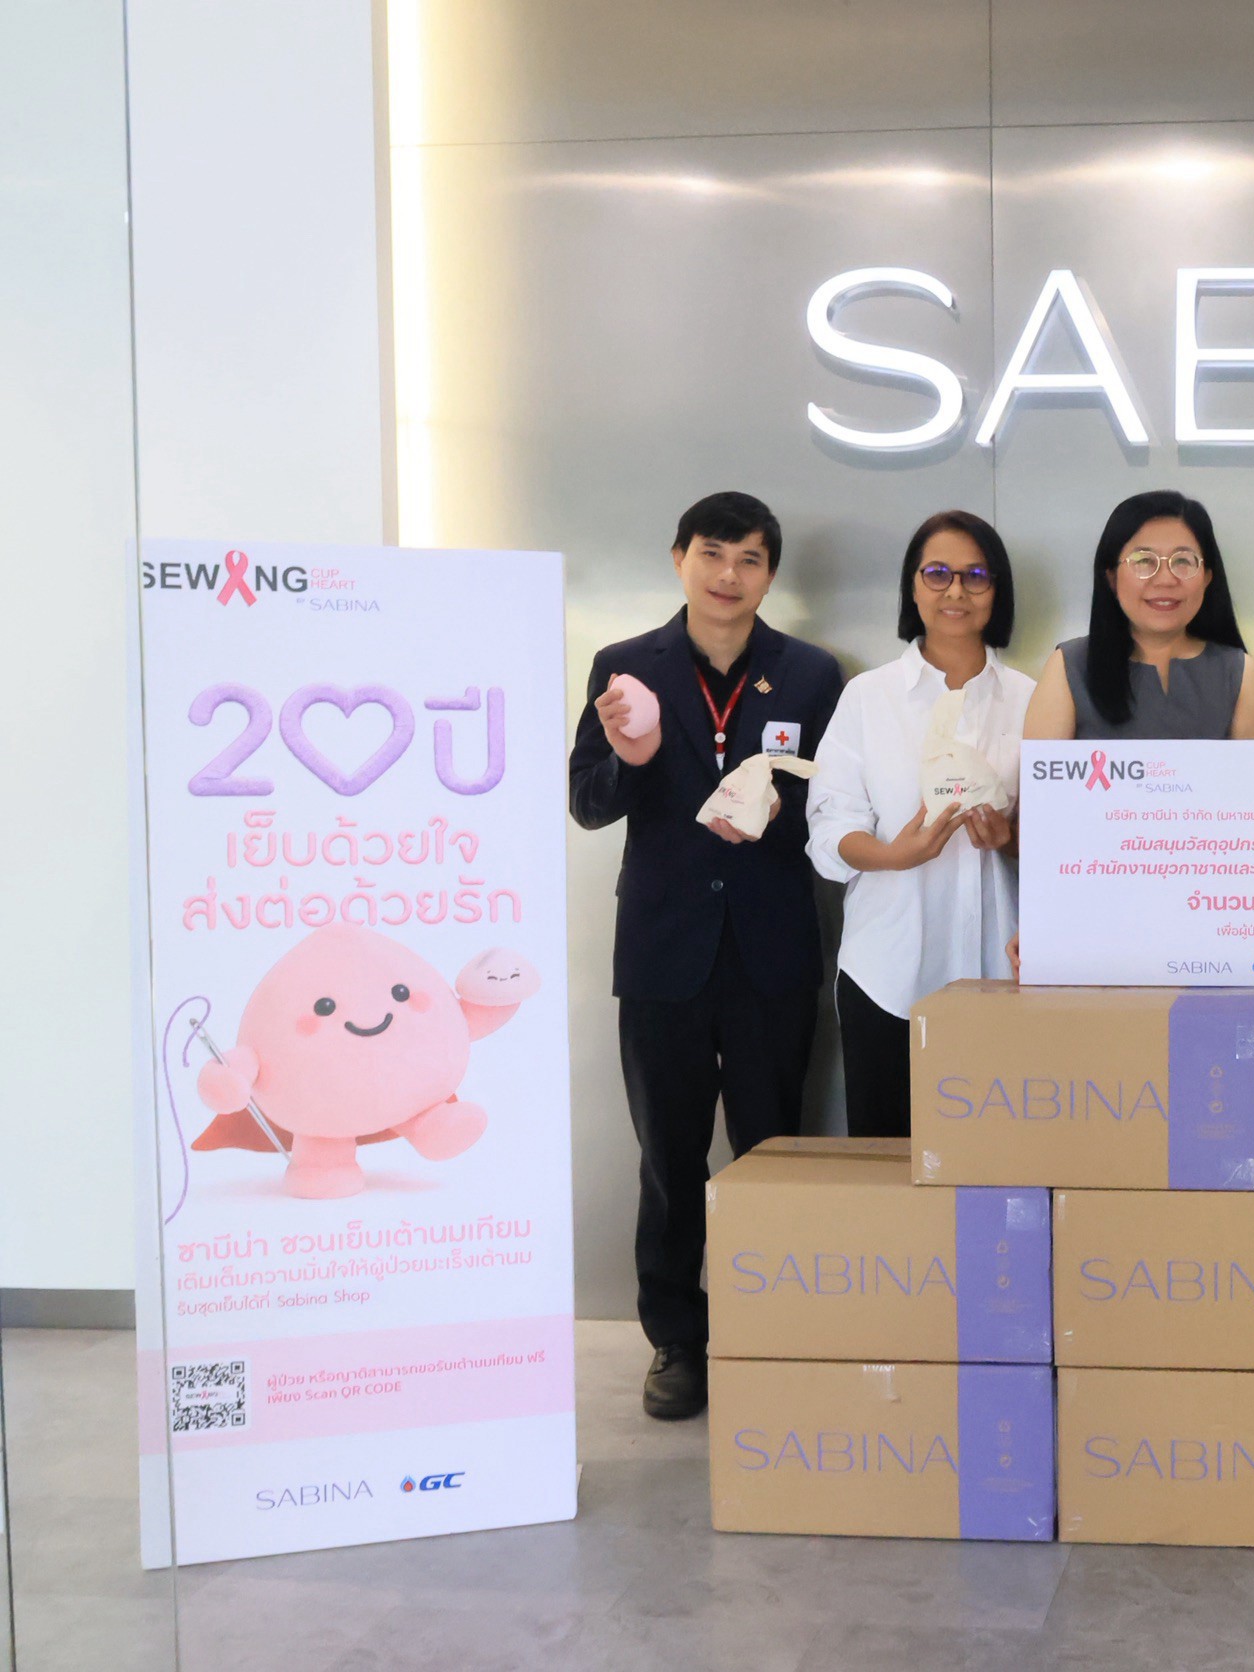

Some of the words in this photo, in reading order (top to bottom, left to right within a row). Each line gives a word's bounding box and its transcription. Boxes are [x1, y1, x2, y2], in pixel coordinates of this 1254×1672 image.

[310, 568, 340, 579] CUP
[310, 579, 356, 591] HEART
[309, 598, 380, 612] SABINA
[1146, 761, 1166, 769] CUP
[1146, 769, 1176, 777] HEART
[1145, 783, 1193, 793] SABINA
[1105, 809, 1137, 821] บริษัท
[1182, 809, 1213, 821] จำกัด
[226, 810, 480, 867] เย็บด้วยใจ
[1059, 859, 1082, 875] แด่
[182, 875, 522, 931] ส่งต่อด้วยรัก
[1167, 961, 1233, 974] SABINA
[936, 1076, 1168, 1122] SABINA
[281, 1214, 532, 1255] ชวนเย็บเต้านมเทียม
[177, 1248, 532, 1292] เติมเต็มความมั่นใจให้ผู้ป่วยมะเร็งเต้านม
[731, 1251, 957, 1296] SABINA
[177, 1291, 271, 1317] รับชุดเย็บได้ที่
[277, 1292, 328, 1307] Sabina
[333, 1288, 370, 1305] Shop
[266, 1371, 305, 1391] ผู้ป่วย
[527, 1350, 545, 1366] ฟรี
[305, 1386, 338, 1401] Scan
[341, 1384, 362, 1400] QR
[364, 1380, 402, 1395] CODE
[734, 1428, 959, 1474] SABINA
[418, 1471, 466, 1491] GC
[256, 1480, 374, 1511] SABINA
